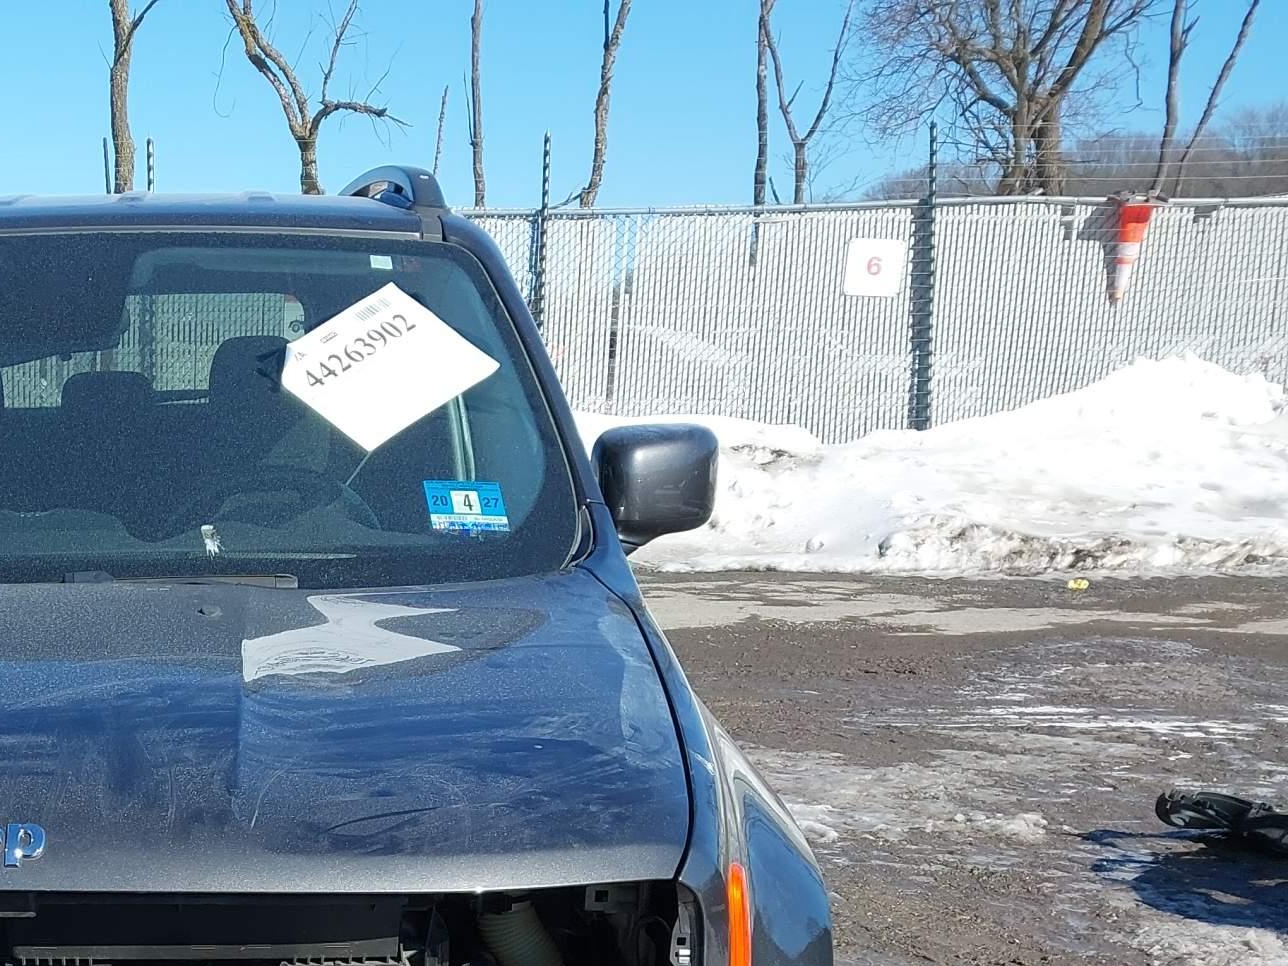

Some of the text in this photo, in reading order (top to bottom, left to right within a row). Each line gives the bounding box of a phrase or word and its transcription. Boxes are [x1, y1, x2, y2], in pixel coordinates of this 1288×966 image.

[865, 255, 883, 277] 6
[305, 314, 416, 388] 44263902
[431, 493, 500, 512] 20 4 27
